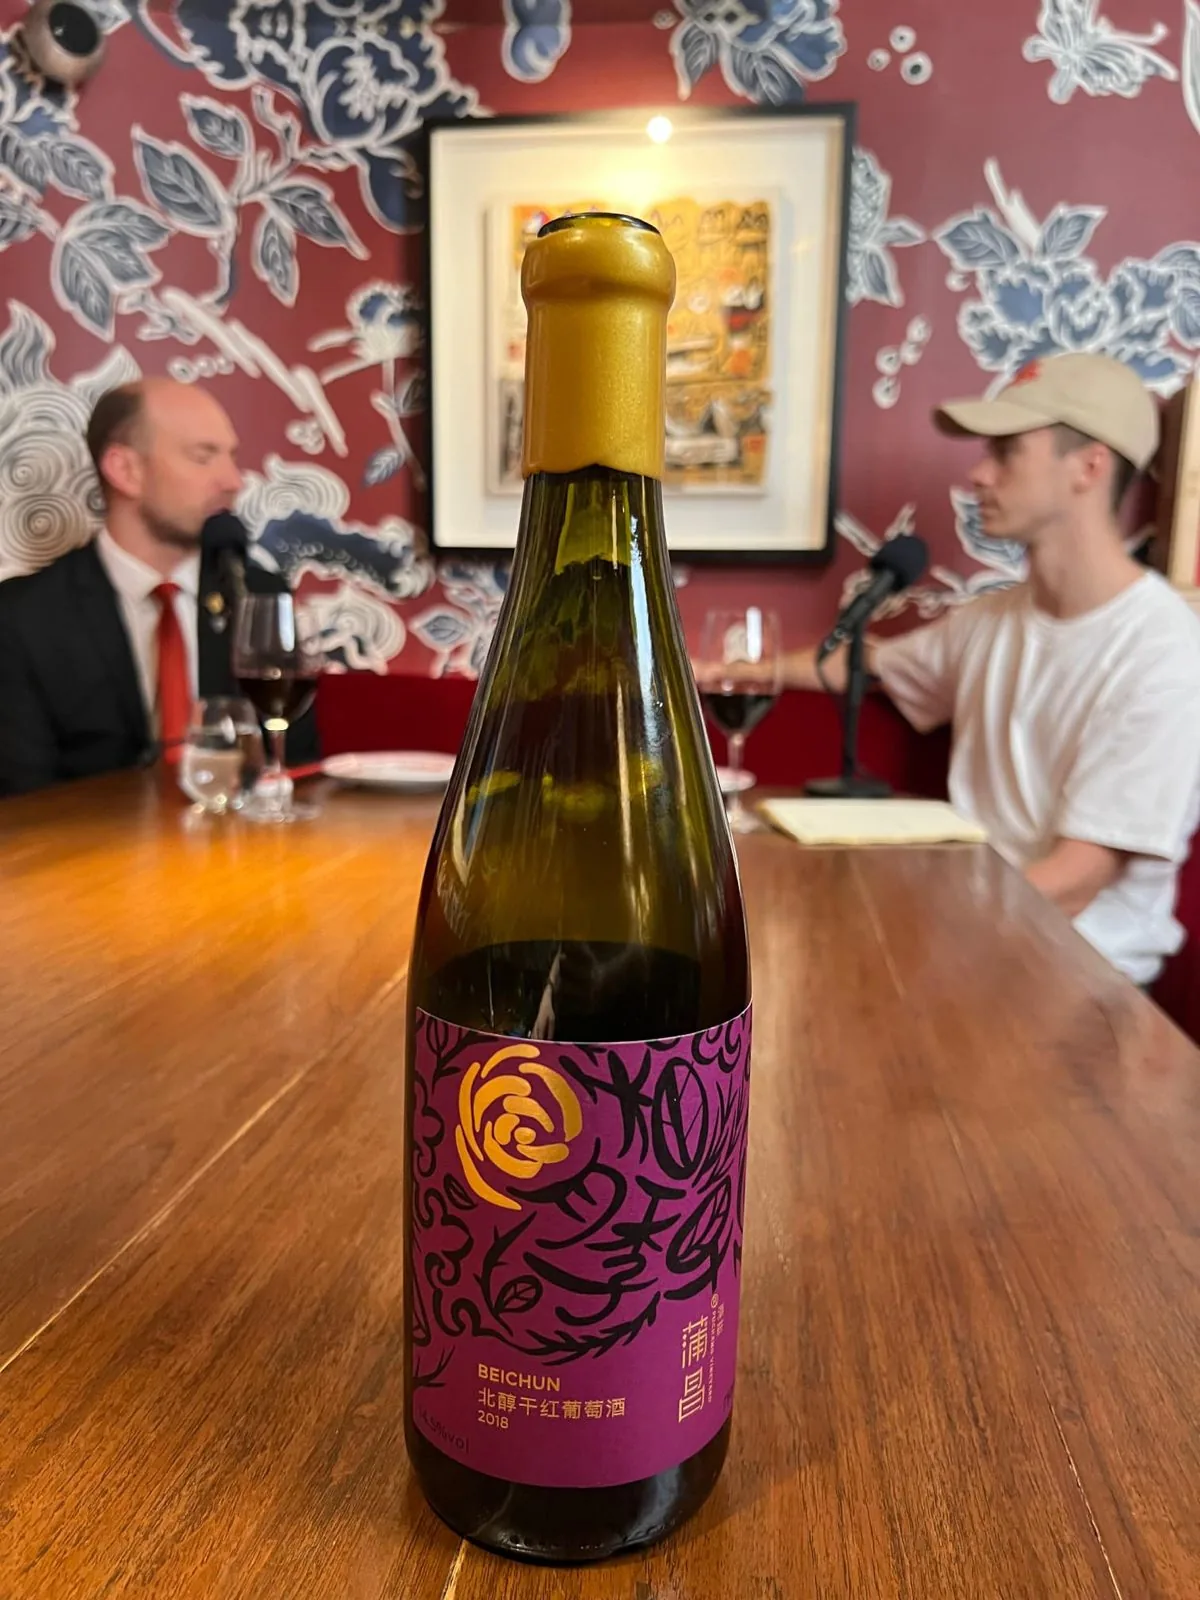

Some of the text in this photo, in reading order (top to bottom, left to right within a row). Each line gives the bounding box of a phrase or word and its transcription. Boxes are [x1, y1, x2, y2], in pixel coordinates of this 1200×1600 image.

[478, 1363, 561, 1392] BEICHUN
[478, 1387, 626, 1419] 北醇干红葡萄酒
[478, 1410, 509, 1430] 2018
